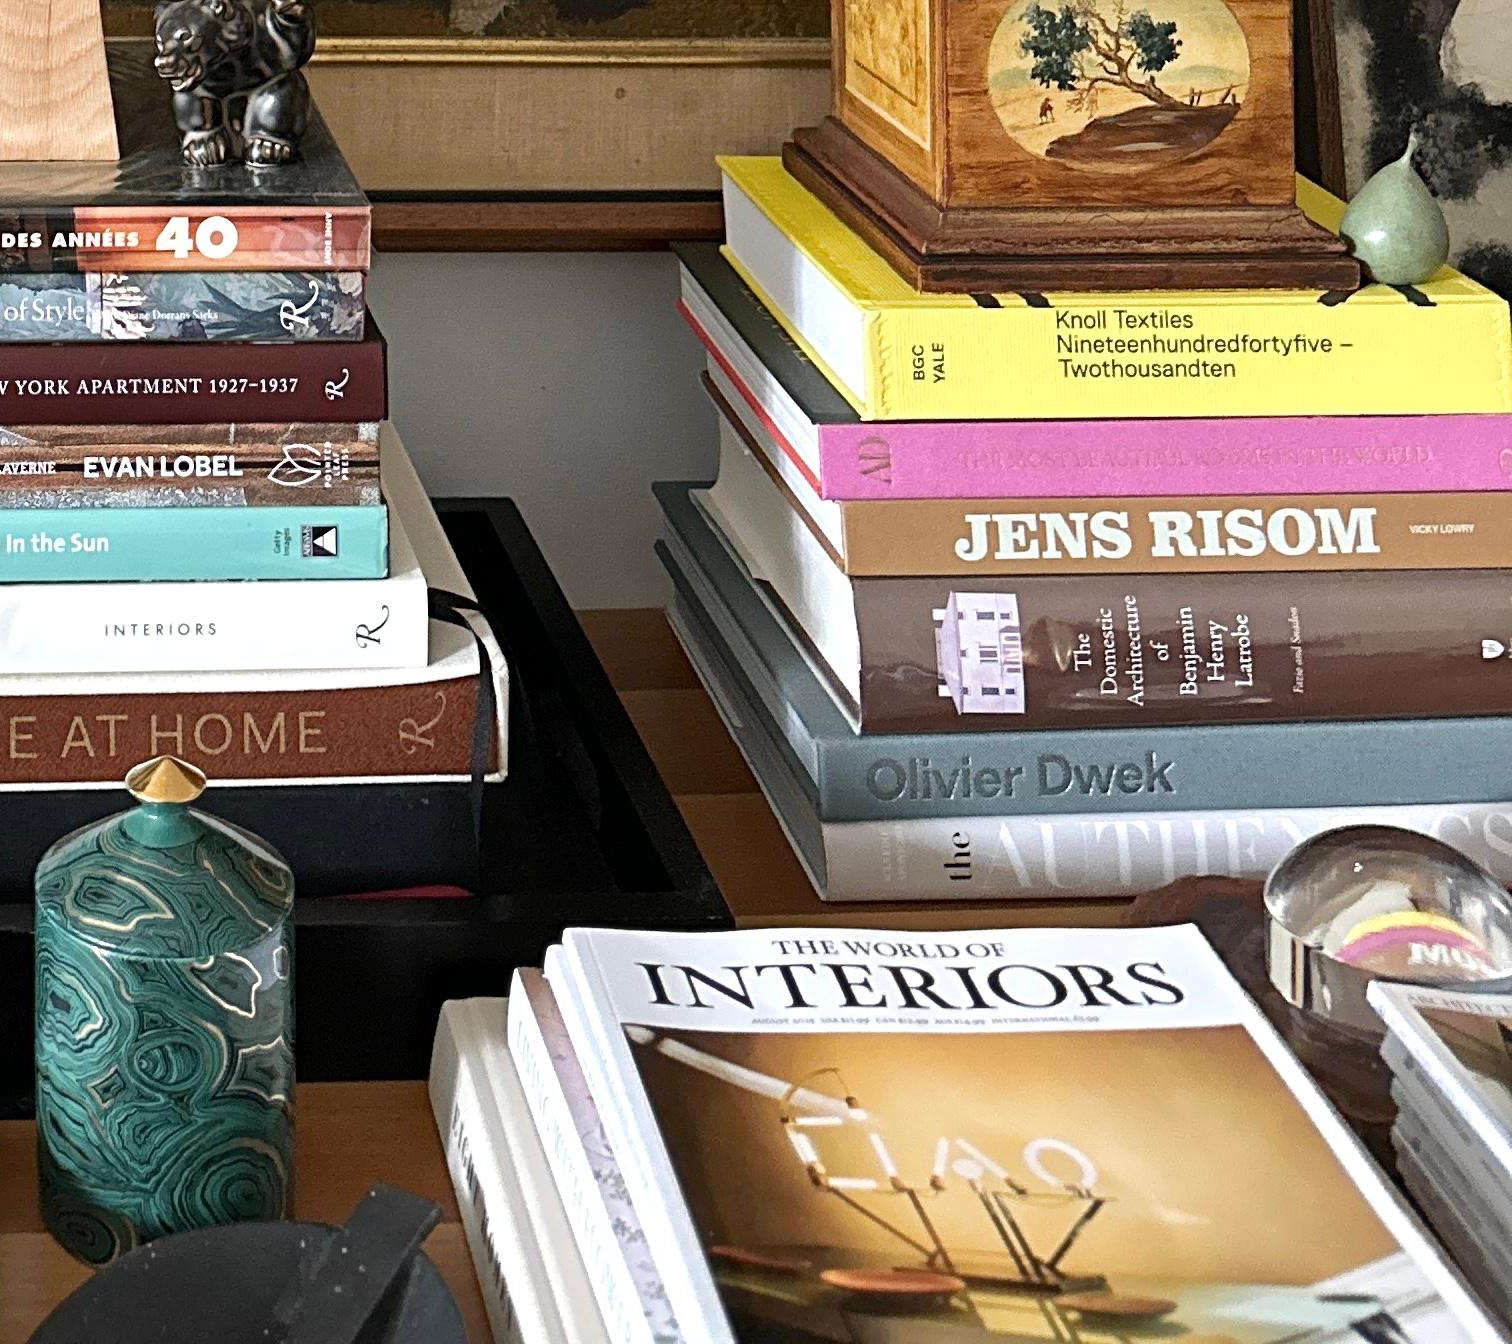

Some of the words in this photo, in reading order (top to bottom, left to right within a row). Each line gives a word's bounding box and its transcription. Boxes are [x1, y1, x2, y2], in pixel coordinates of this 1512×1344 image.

[2, 233, 43, 249] DES
[52, 228, 140, 248] ANNÉES
[155, 215, 239, 260] 40
[4, 299, 30, 323] of
[32, 300, 85, 328] Style
[1055, 309, 1107, 330] Knoll
[1114, 309, 1194, 330] Textiles
[912, 343, 925, 381] BGC
[933, 342, 946, 384] YALE
[1057, 333, 1334, 357] Nineteenhundredfortyfive
[15, 379, 69, 395] YORK
[76, 378, 202, 395] APARTMENT
[1058, 358, 1236, 379] Twothousandten
[83, 455, 155, 479] EVAN
[160, 454, 243, 478] LOBEL
[6, 533, 25, 554] In
[29, 532, 67, 553] the
[71, 532, 110, 553] Sun
[954, 511, 1132, 562] JENS
[1148, 507, 1381, 559] RISOM
[1409, 524, 1438, 535] VICKY
[1439, 524, 1475, 535] LOWRY
[104, 623, 218, 637] INTERIORS
[1073, 633, 1092, 672] The
[1096, 607, 1118, 695] Domestic
[1124, 594, 1144, 707] Architecture
[1149, 640, 1169, 662] of
[1175, 606, 1203, 696] Benjamin
[1206, 620, 1228, 682] Henry
[1231, 614, 1253, 688] Latrobe
[1290, 645, 1304, 665] and
[60, 713, 129, 760] AT
[150, 709, 328, 759] HOME
[865, 755, 1025, 802] Olivier
[1037, 750, 1178, 799] Dwek
[943, 830, 972, 882] the
[772, 940, 839, 957] THE
[842, 940, 960, 959] WORLD
[966, 941, 1006, 958] OF
[634, 961, 1185, 1011] INTERIORS
